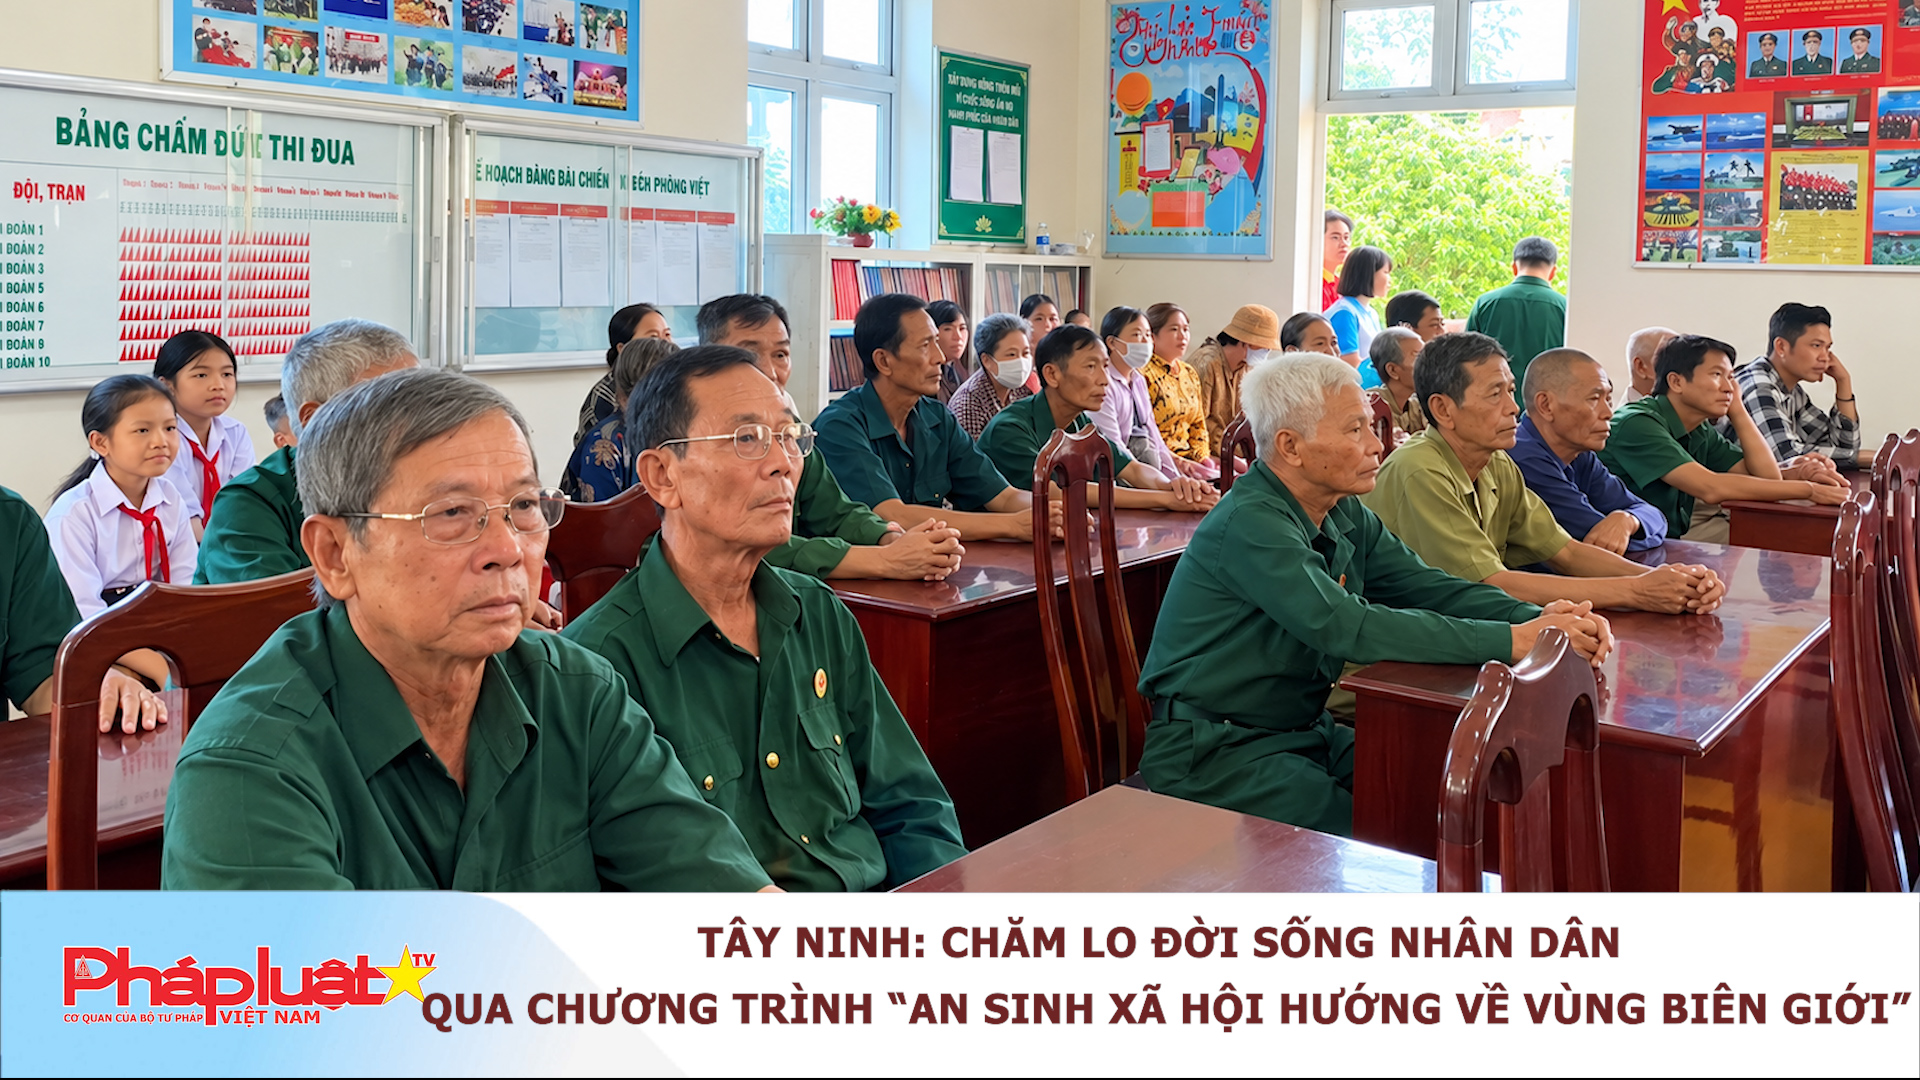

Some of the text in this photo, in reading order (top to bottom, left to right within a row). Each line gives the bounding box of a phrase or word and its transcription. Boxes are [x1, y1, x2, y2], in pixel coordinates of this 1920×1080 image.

[56, 108, 129, 150] BẢNG
[137, 116, 207, 155] CHẤM
[269, 134, 304, 162] THI
[311, 138, 355, 165] ĐUA
[13, 178, 86, 205] ĐỘI, TRẠN
[38, 243, 44, 255] 2
[38, 262, 44, 275] 3
[38, 282, 44, 294] 5
[38, 301, 44, 313] 6
[38, 320, 44, 332] 7
[38, 356, 51, 368] 10
